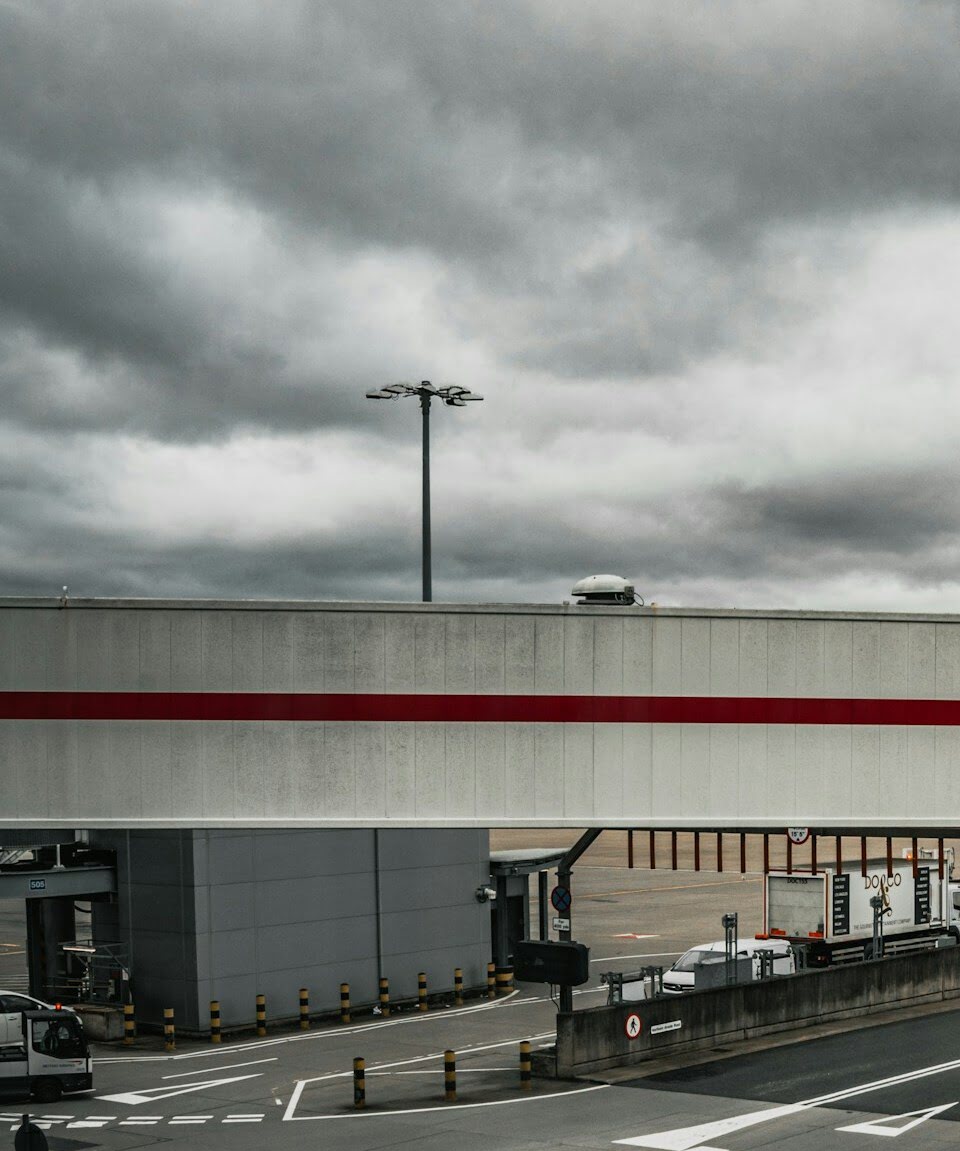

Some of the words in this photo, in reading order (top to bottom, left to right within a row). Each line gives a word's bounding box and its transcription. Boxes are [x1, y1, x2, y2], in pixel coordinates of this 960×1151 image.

[31, 881, 46, 889] 505
[864, 875, 880, 889] DO
[887, 873, 902, 888] CO
